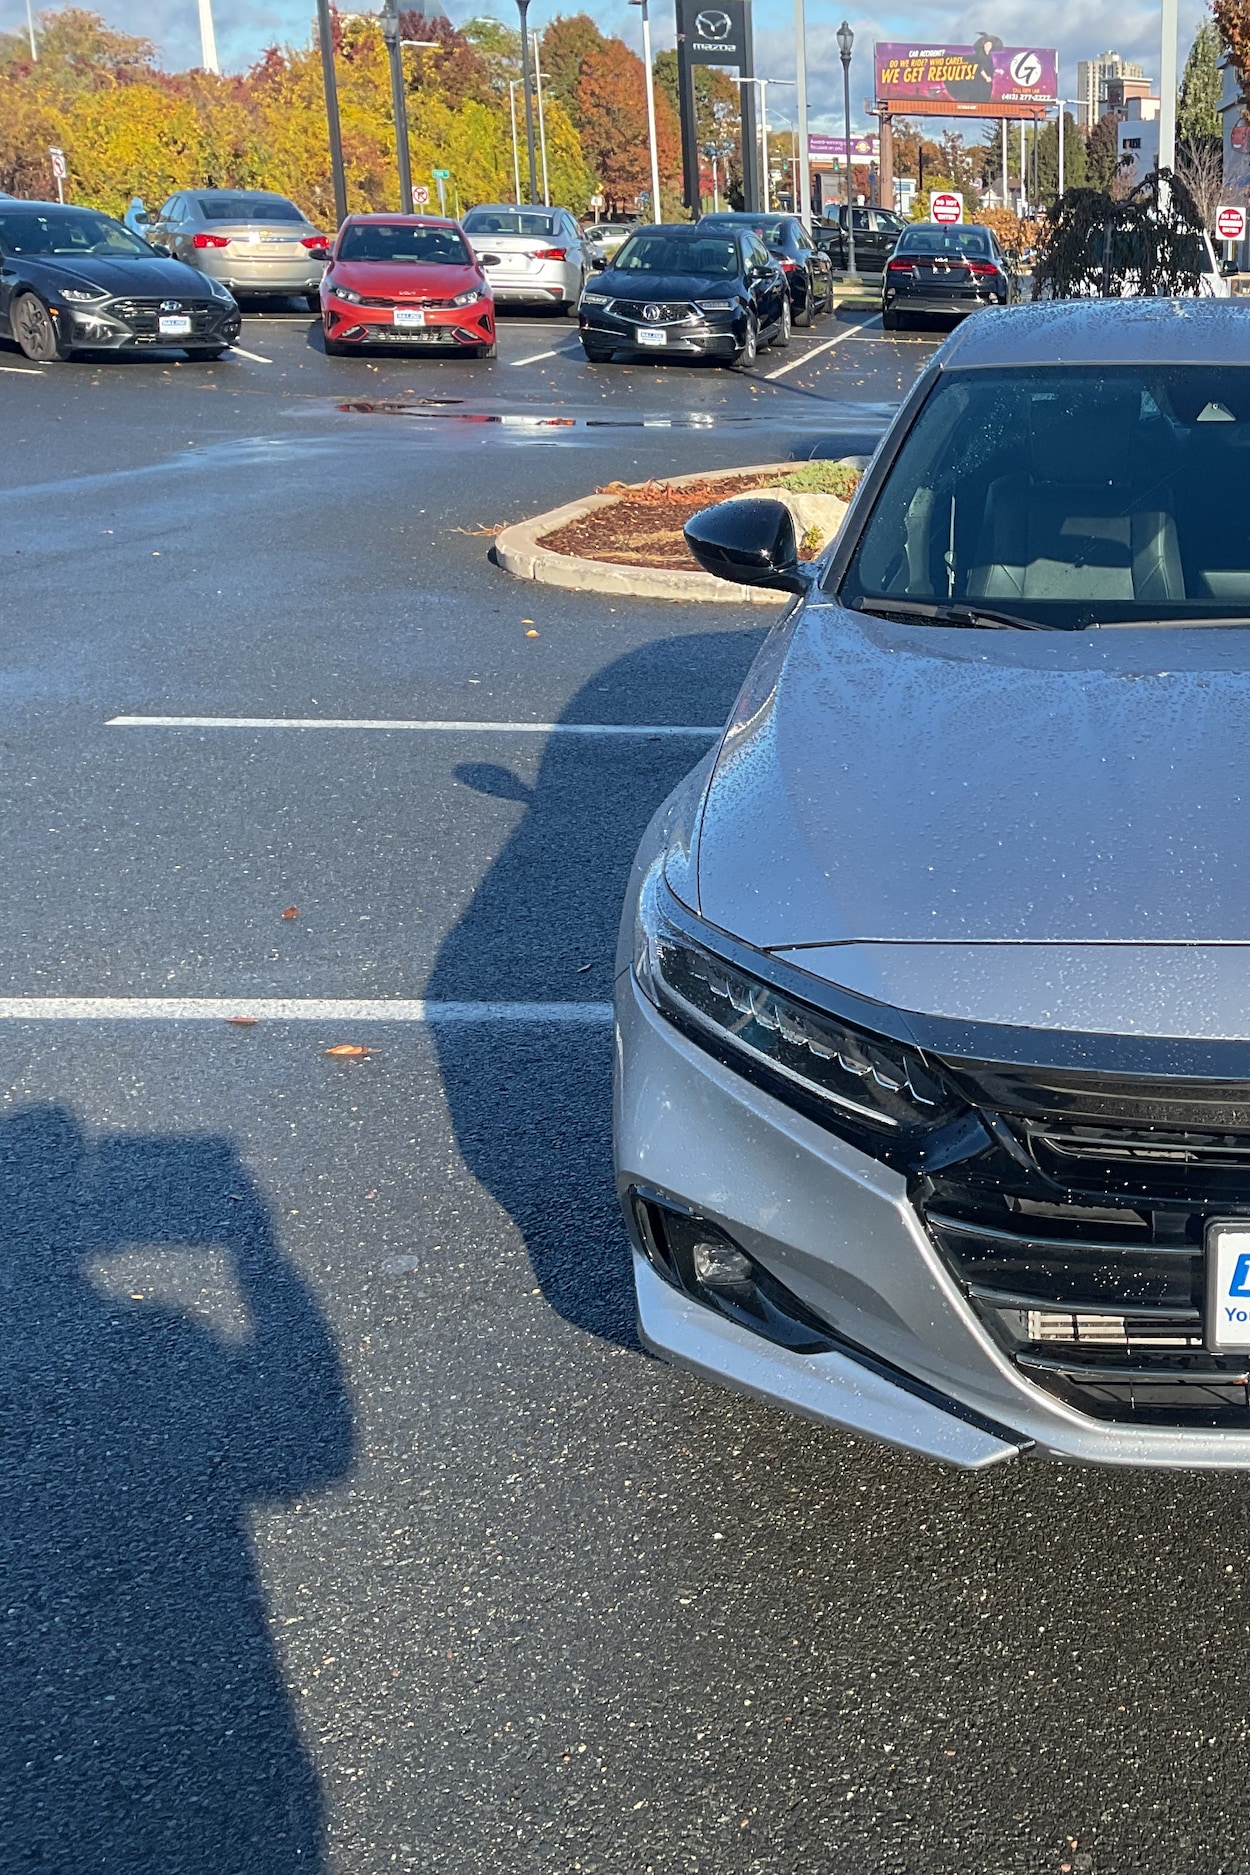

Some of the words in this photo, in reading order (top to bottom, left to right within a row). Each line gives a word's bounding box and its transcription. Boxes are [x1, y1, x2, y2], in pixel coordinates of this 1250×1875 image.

[889, 60, 899, 68] DO
[900, 60, 909, 68] WE
[911, 58, 928, 67] RIDE?
[930, 58, 944, 66] WHO
[881, 68, 900, 84] WE
[904, 67, 924, 83] GET
[928, 63, 979, 82] RESULTS!
[937, 213, 957, 221] ENTER
